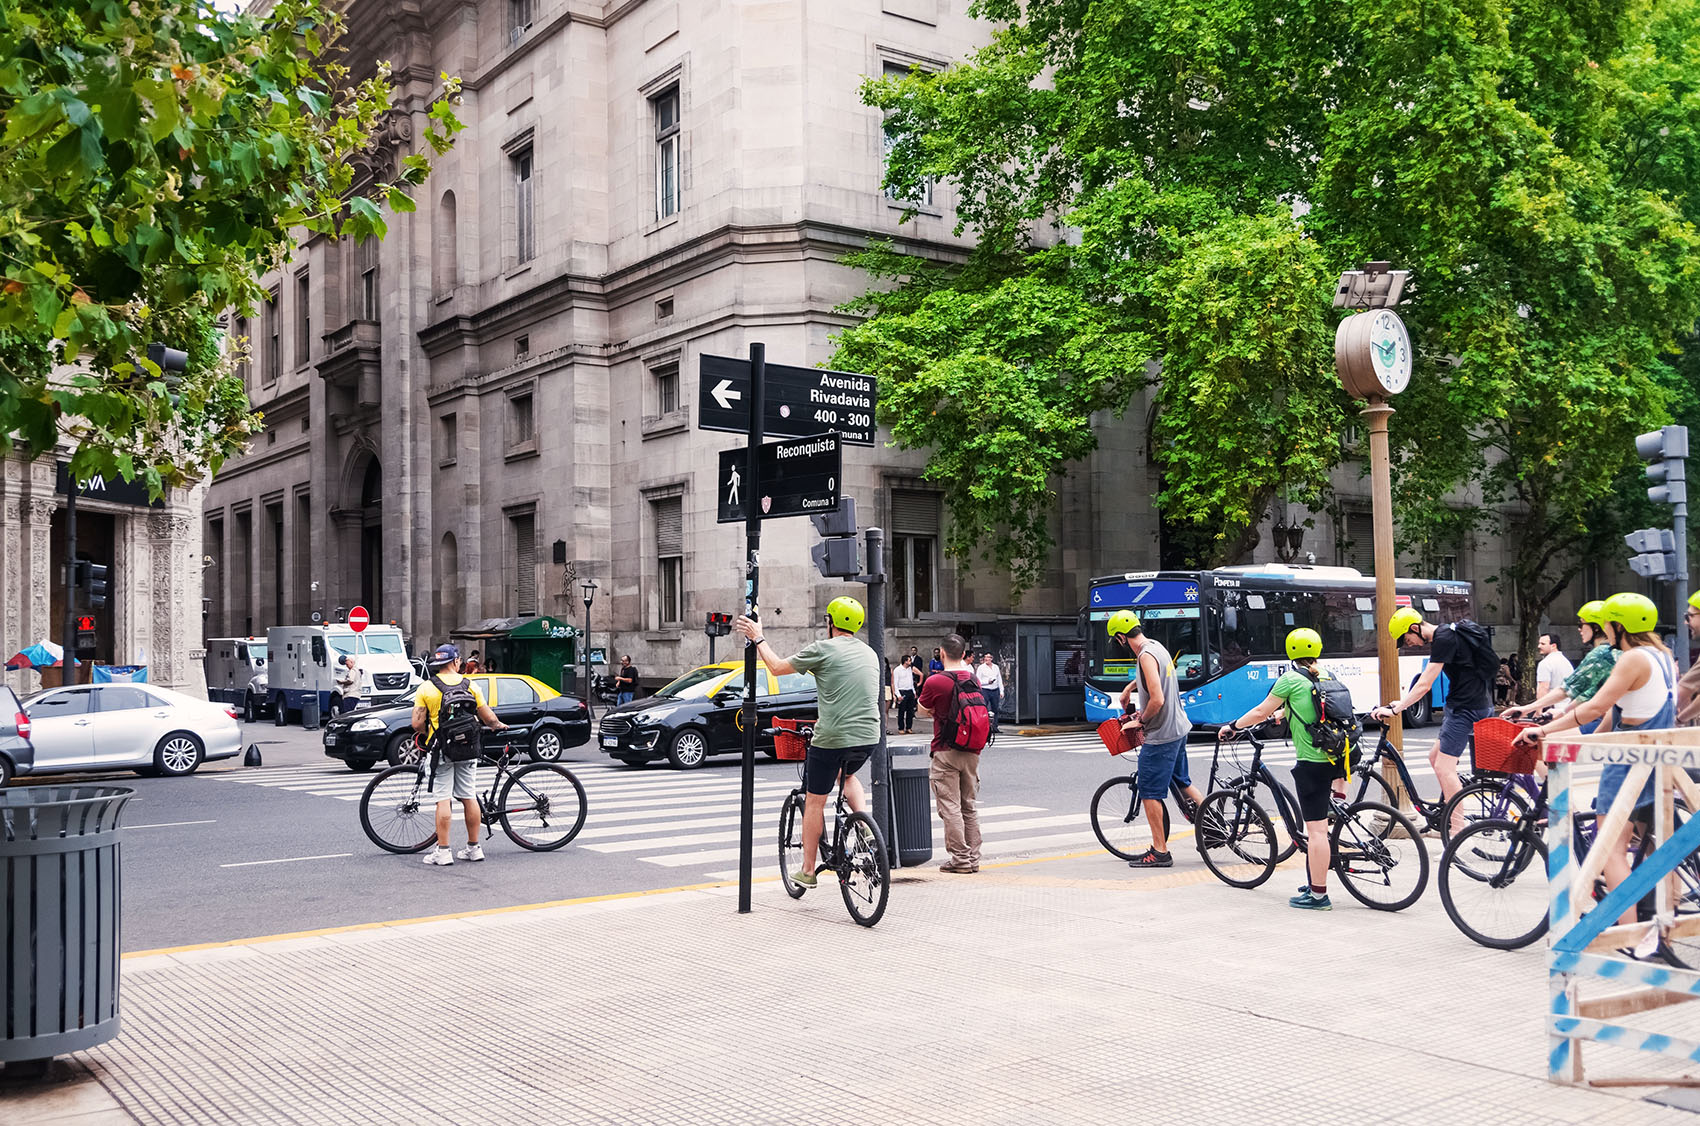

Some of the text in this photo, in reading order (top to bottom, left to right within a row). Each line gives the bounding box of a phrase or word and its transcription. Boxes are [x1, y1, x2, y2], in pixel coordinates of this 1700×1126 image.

[1381, 315, 1390, 330] 12
[1400, 347, 1406, 362] 3
[820, 373, 870, 392] Avenida
[810, 388, 870, 408] Rivadavia
[813, 409, 837, 424] 400
[847, 412, 870, 427] 300
[864, 431, 869, 440] 1
[776, 438, 835, 459] Reconquista
[828, 477, 835, 491] 0
[802, 496, 835, 508] Comuna 1
[1128, 581, 1154, 604] 7
[1246, 670, 1259, 680] 1427
[1279, 667, 1284, 675] 7
[1590, 746, 1696, 767] COSUGA
